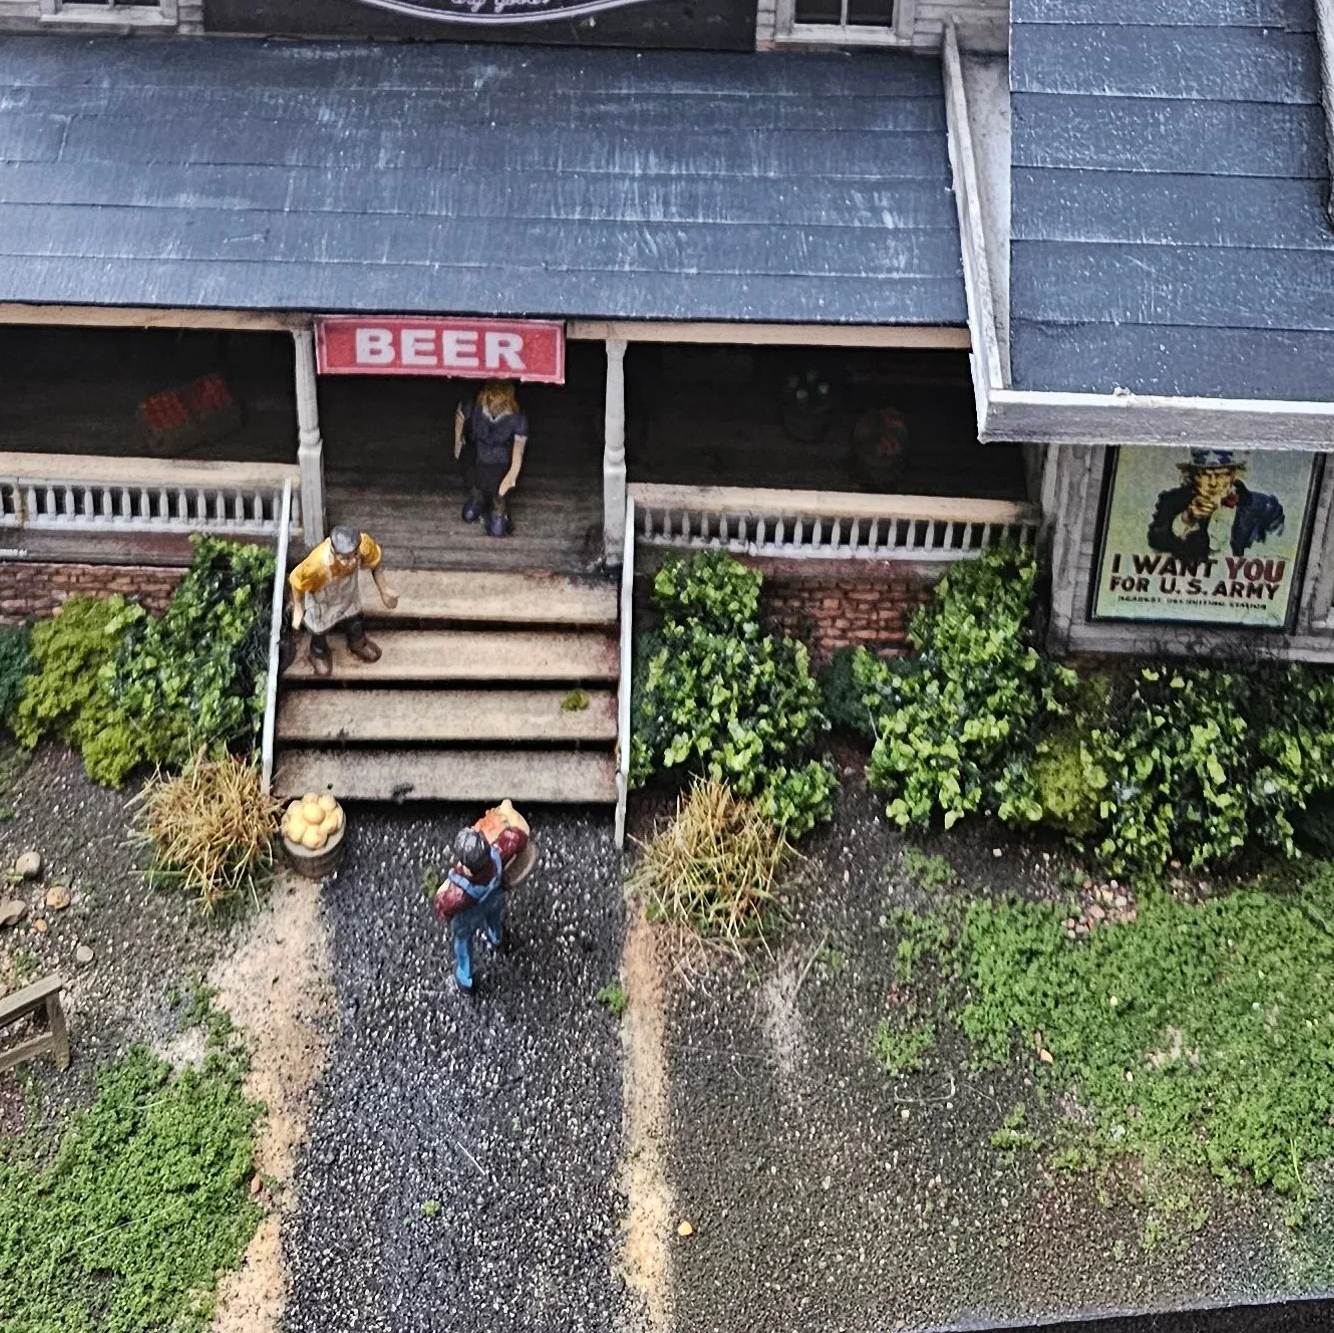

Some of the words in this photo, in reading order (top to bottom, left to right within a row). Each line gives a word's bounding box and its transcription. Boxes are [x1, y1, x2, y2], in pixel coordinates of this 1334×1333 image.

[355, 328, 526, 370] BEER
[1112, 553, 1121, 574] I
[1132, 554, 1218, 578] WANT
[1225, 556, 1286, 583] YOU
[1109, 576, 1150, 593] FOR
[1212, 580, 1280, 601] ARMY
